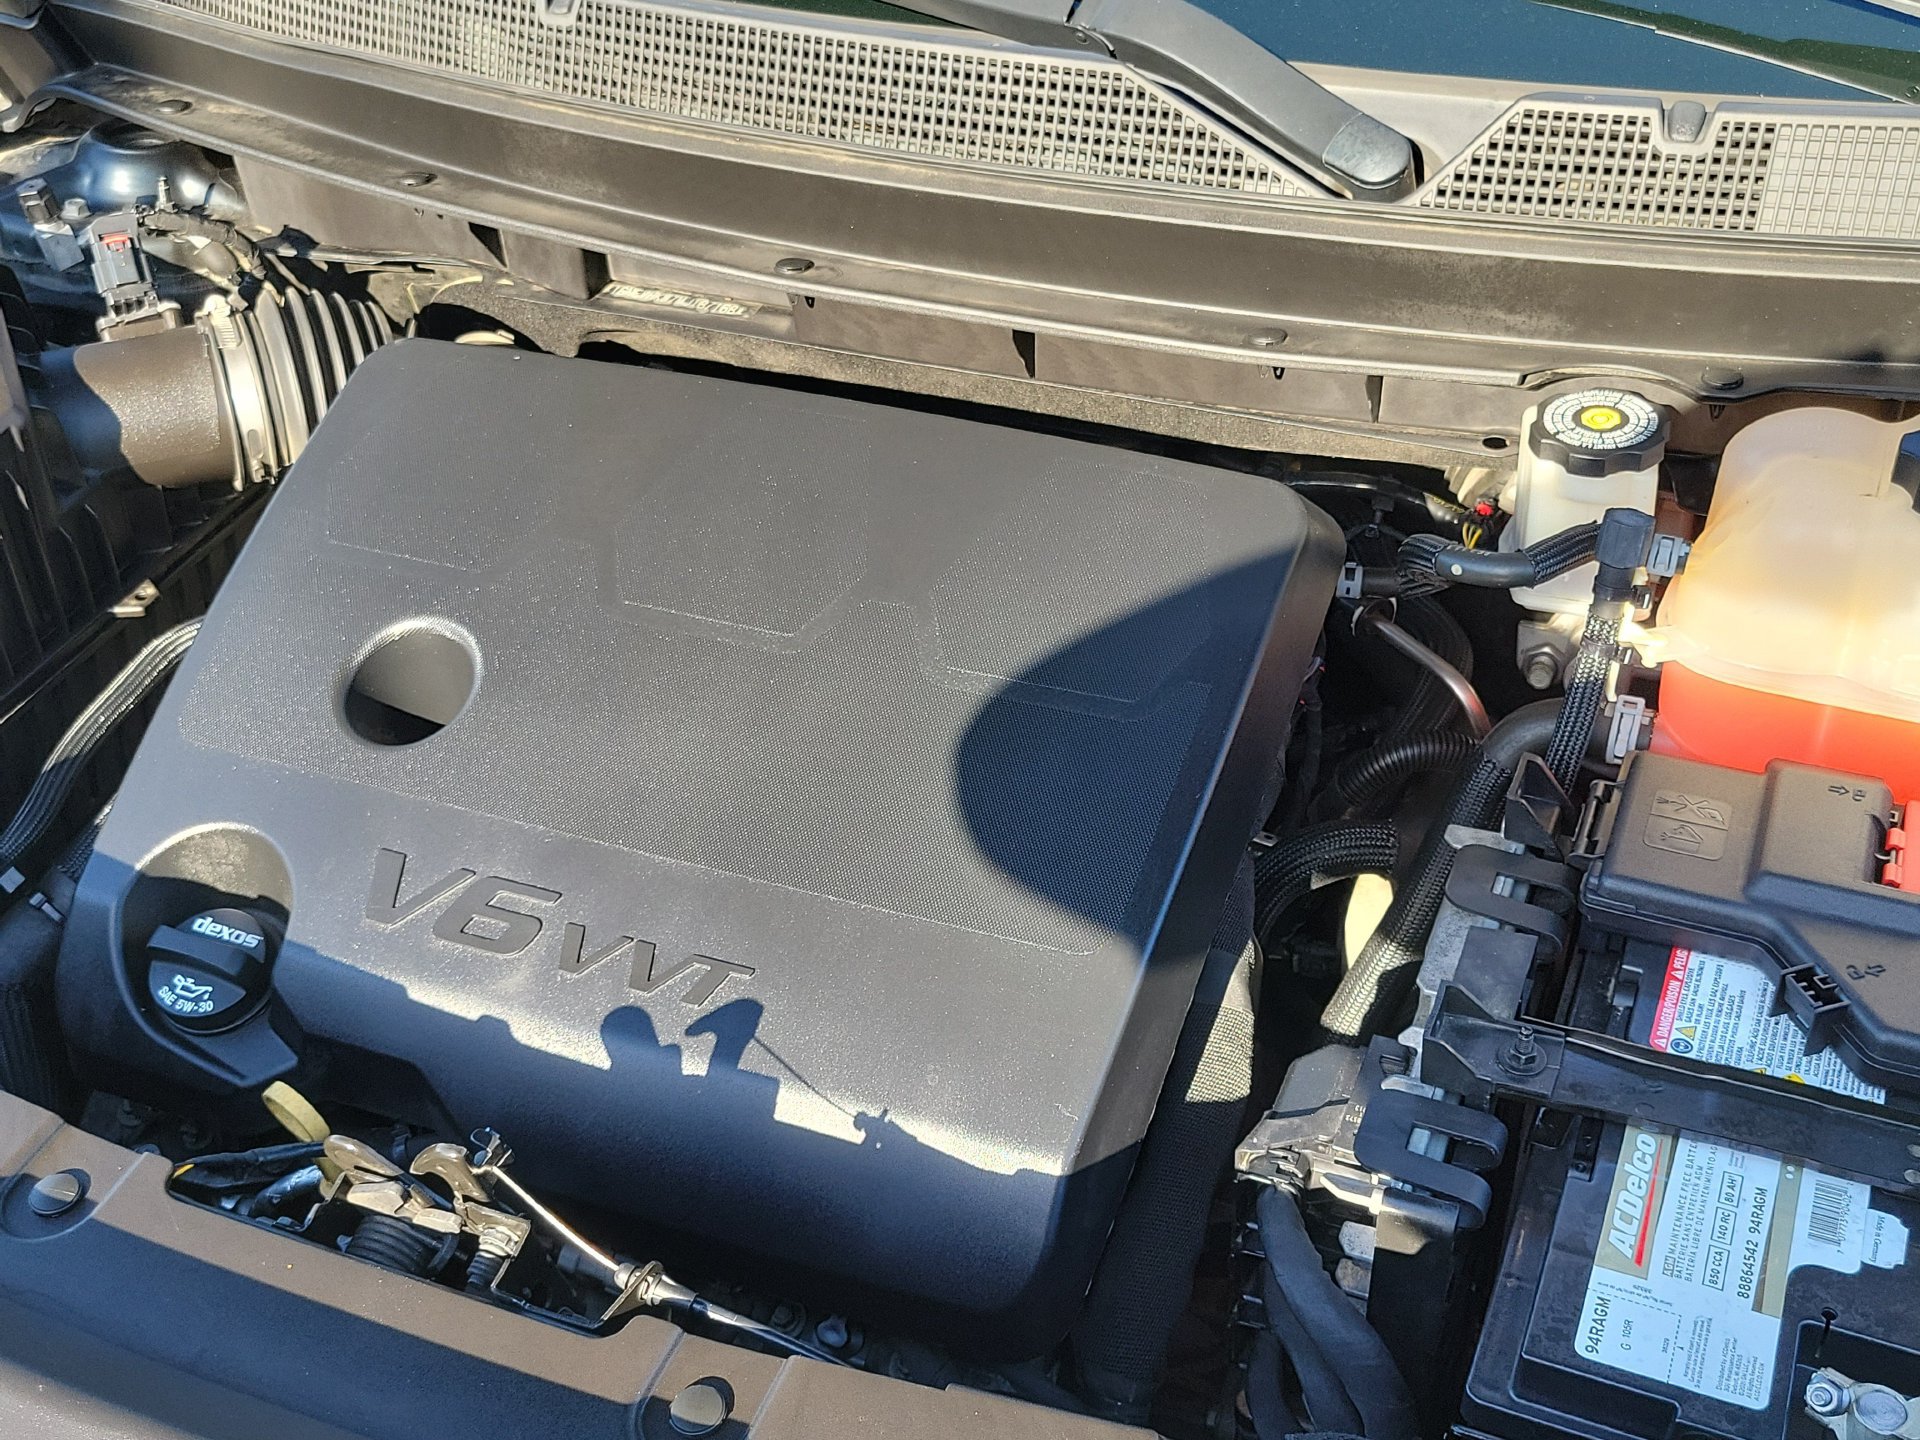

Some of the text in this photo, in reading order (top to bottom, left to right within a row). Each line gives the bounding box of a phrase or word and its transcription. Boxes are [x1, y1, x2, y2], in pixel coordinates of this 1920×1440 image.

[192, 916, 262, 948] dexos
[365, 848, 757, 1008] V6 VVT
[158, 986, 214, 1013] SAE 5W-30
[1607, 1133, 1657, 1259] ACDelco
[1698, 1156, 1715, 1214] MANTENIMIENTO
[1724, 1192, 1735, 1203] 80
[1668, 1195, 1687, 1254] MAINTENANCE
[1680, 1171, 1691, 1192] FREE
[1674, 1165, 1703, 1279] BATTERIE SANS ENTRETIEN AGM
[1695, 1216, 1704, 1225] DE
[1720, 1211, 1731, 1224] RC
[1691, 1228, 1702, 1249] LIBRE
[1717, 1225, 1728, 1240] 140
[1737, 1187, 1767, 1298] 88864542 94RAGM
[1712, 1251, 1724, 1266] CCA
[1708, 1268, 1720, 1285] 850
[1584, 1296, 1611, 1354] 94RAGM
[1620, 1319, 1634, 1351] G 105R
